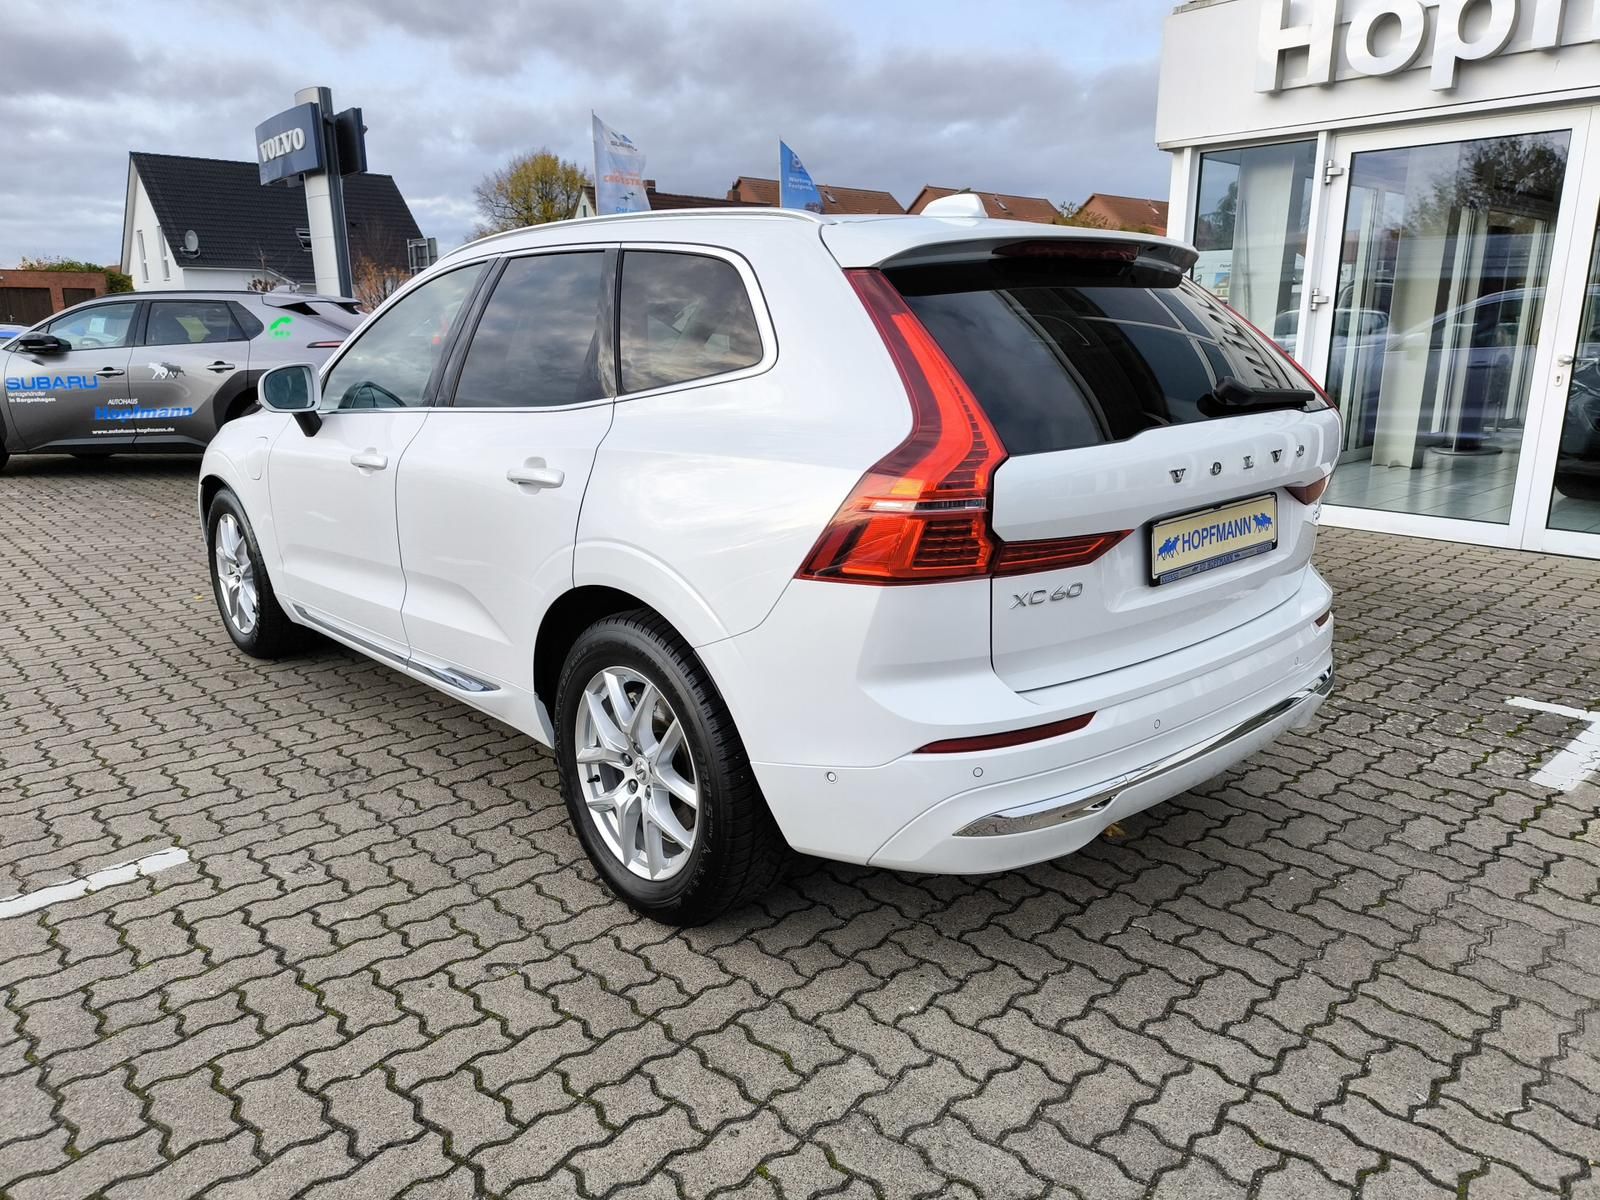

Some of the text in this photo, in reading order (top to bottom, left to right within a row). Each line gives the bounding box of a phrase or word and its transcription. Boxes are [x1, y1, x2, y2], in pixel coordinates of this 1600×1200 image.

[1256, 0, 1600, 92] Hop
[260, 127, 306, 163] VOLVO
[5, 375, 98, 390] SUBARU
[95, 405, 193, 422] Hopfmann
[1169, 444, 1305, 484] VOLVO
[1182, 515, 1251, 553] HOPFMANN
